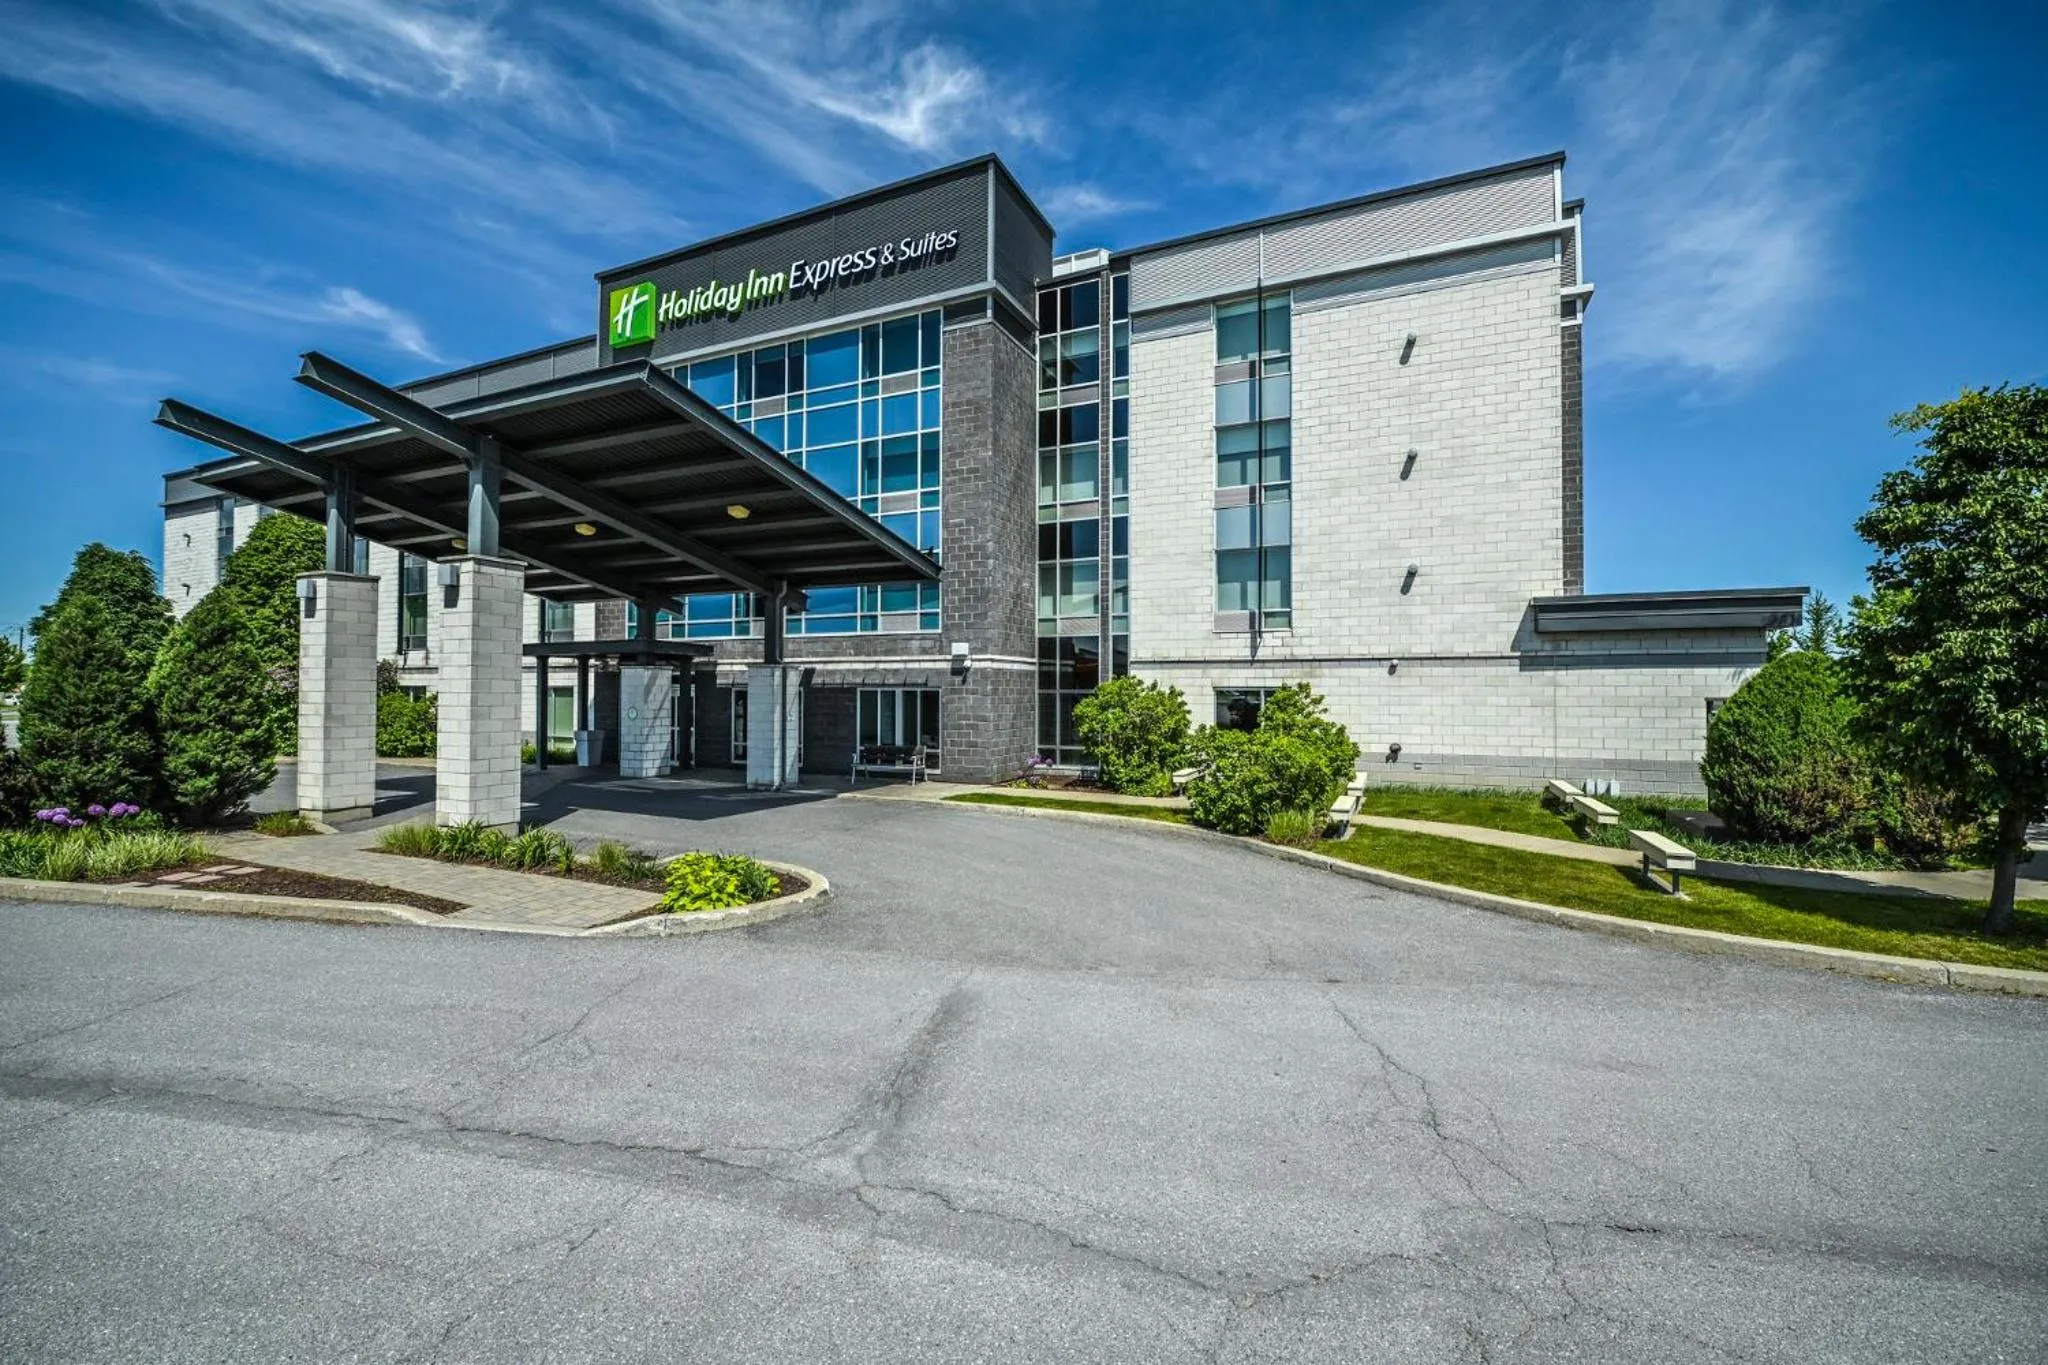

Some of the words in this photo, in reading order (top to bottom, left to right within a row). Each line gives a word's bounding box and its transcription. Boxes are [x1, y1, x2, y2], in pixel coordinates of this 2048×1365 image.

[658, 281, 744, 321] Holiday
[746, 269, 785, 299] Inn
[789, 247, 878, 290] Express
[880, 242, 895, 265] &
[898, 230, 958, 261] Suites
